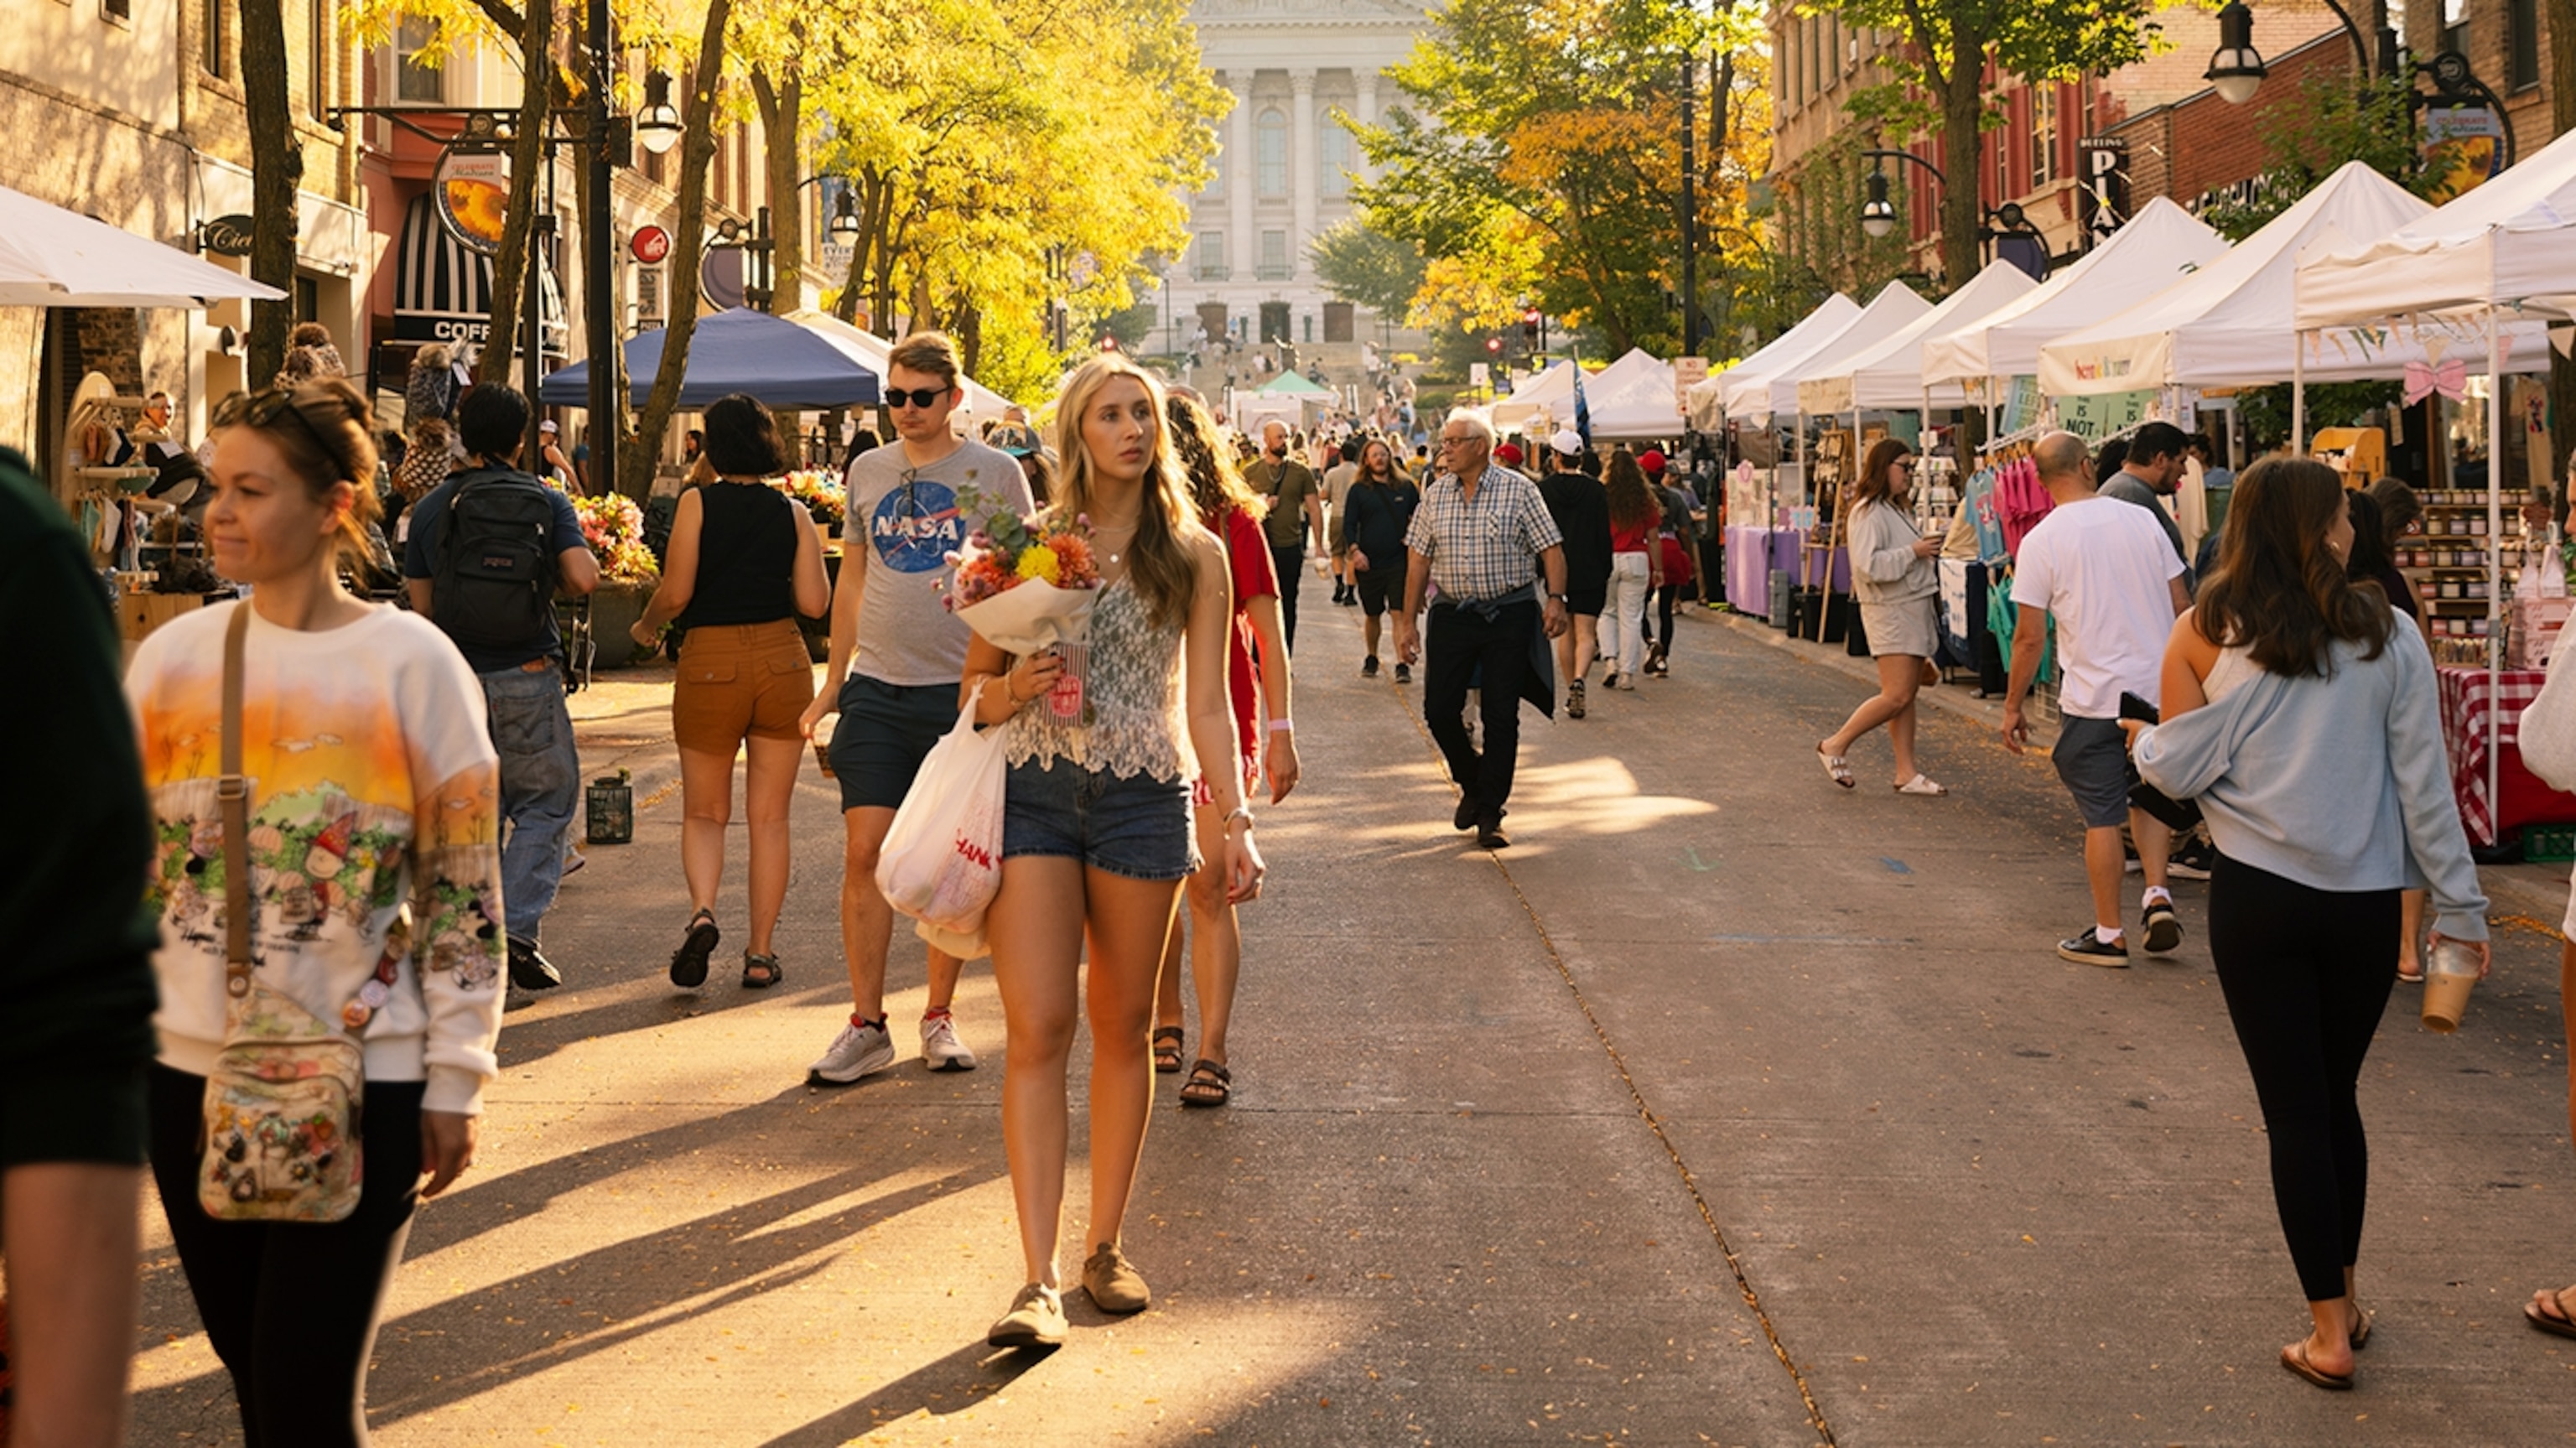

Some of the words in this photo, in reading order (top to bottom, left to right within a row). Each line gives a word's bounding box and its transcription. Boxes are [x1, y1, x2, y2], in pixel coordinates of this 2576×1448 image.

[434, 321, 491, 340] COFF
[2076, 405, 2087, 417] IS
[2126, 409, 2137, 422] IS
[2065, 418, 2096, 437] NOT
[875, 515, 958, 541] NASA
